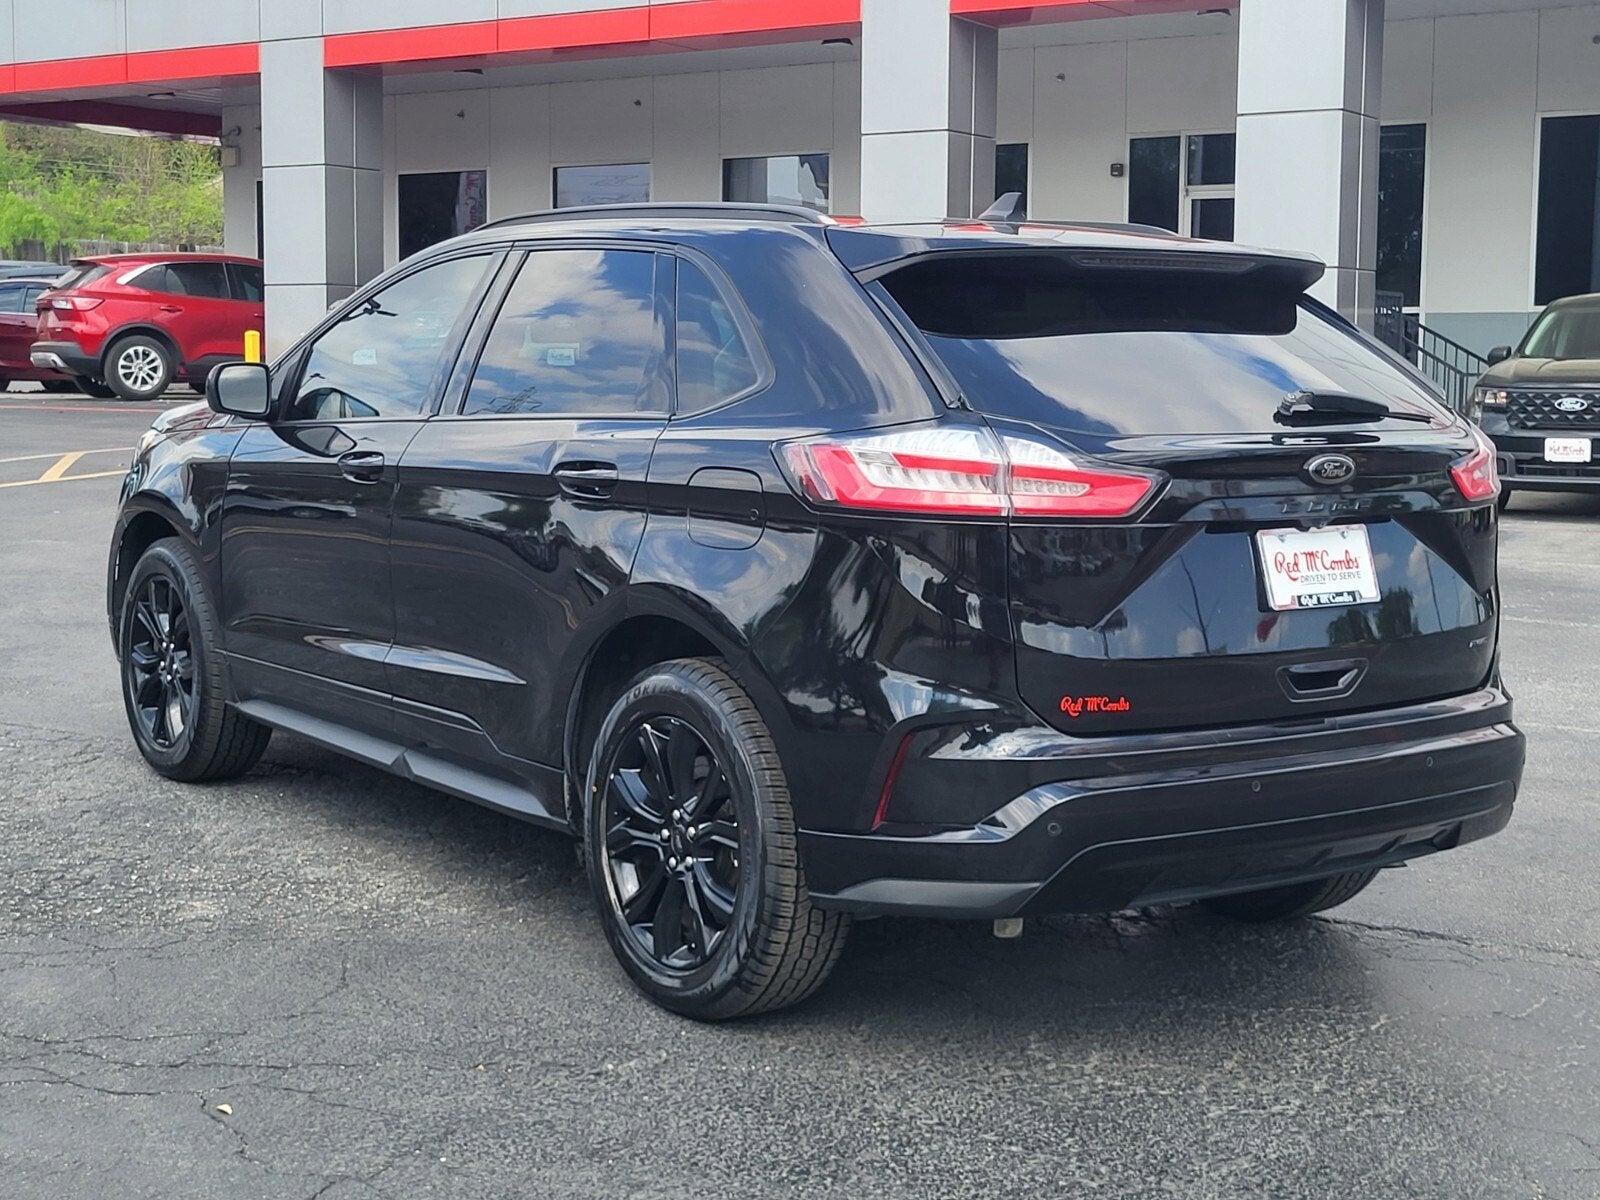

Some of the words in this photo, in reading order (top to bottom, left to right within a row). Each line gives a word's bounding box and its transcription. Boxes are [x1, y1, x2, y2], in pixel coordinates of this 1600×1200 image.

[1321, 461, 1347, 478] Ford
[1274, 551, 1300, 582] Red
[1301, 549, 1360, 571] McCombs
[1300, 573, 1326, 583] DRIVEN
[1328, 572, 1338, 582] TO
[1339, 571, 1362, 580] SERVE
[1300, 594, 1318, 607] Red
[1060, 696, 1083, 717] Red
[1084, 696, 1130, 711] McCombs
